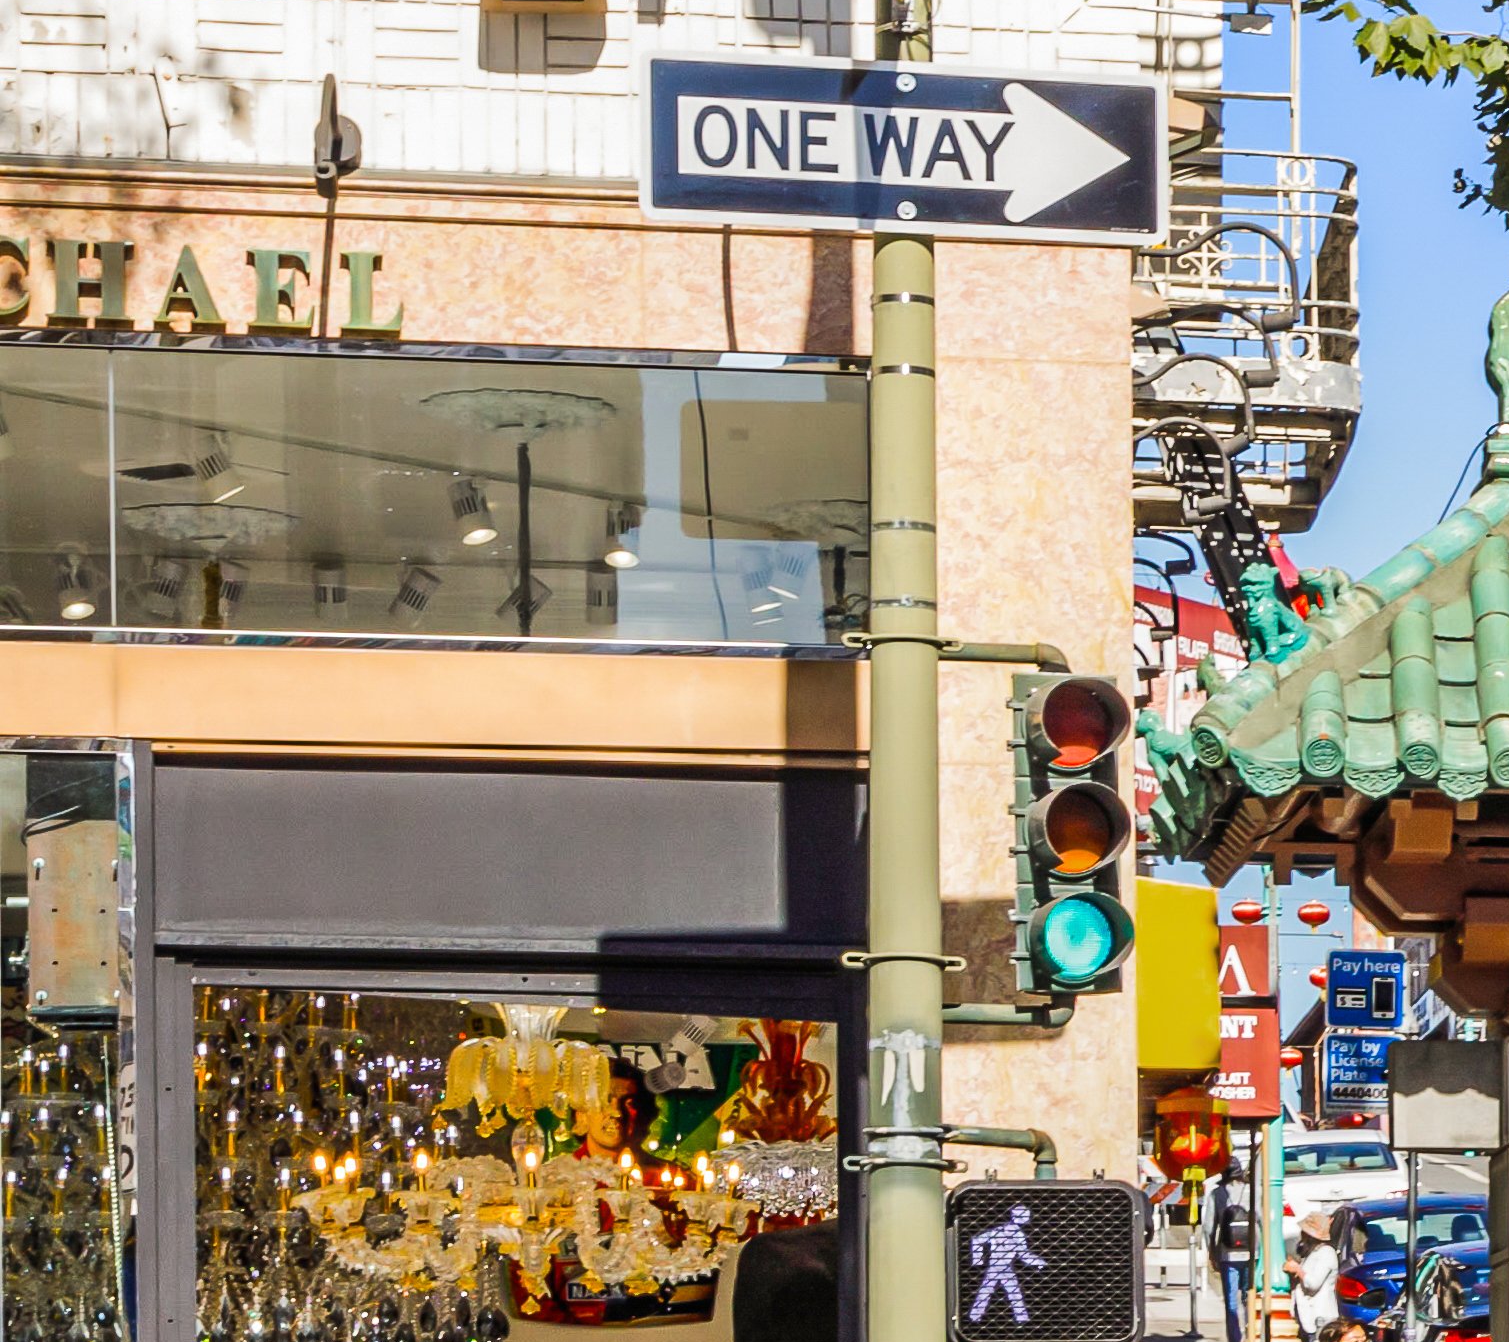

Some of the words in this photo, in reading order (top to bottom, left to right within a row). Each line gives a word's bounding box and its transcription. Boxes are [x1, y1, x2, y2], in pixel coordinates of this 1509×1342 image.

[693, 104, 839, 174] ONE
[863, 112, 1016, 182] WAY
[1333, 958, 1361, 975] Pay
[1364, 957, 1401, 974] here
[1331, 1040, 1358, 1056] Pay
[1361, 1040, 1381, 1056] by
[1331, 1053, 1384, 1067] License
[1331, 1068, 1368, 1081] Plate
